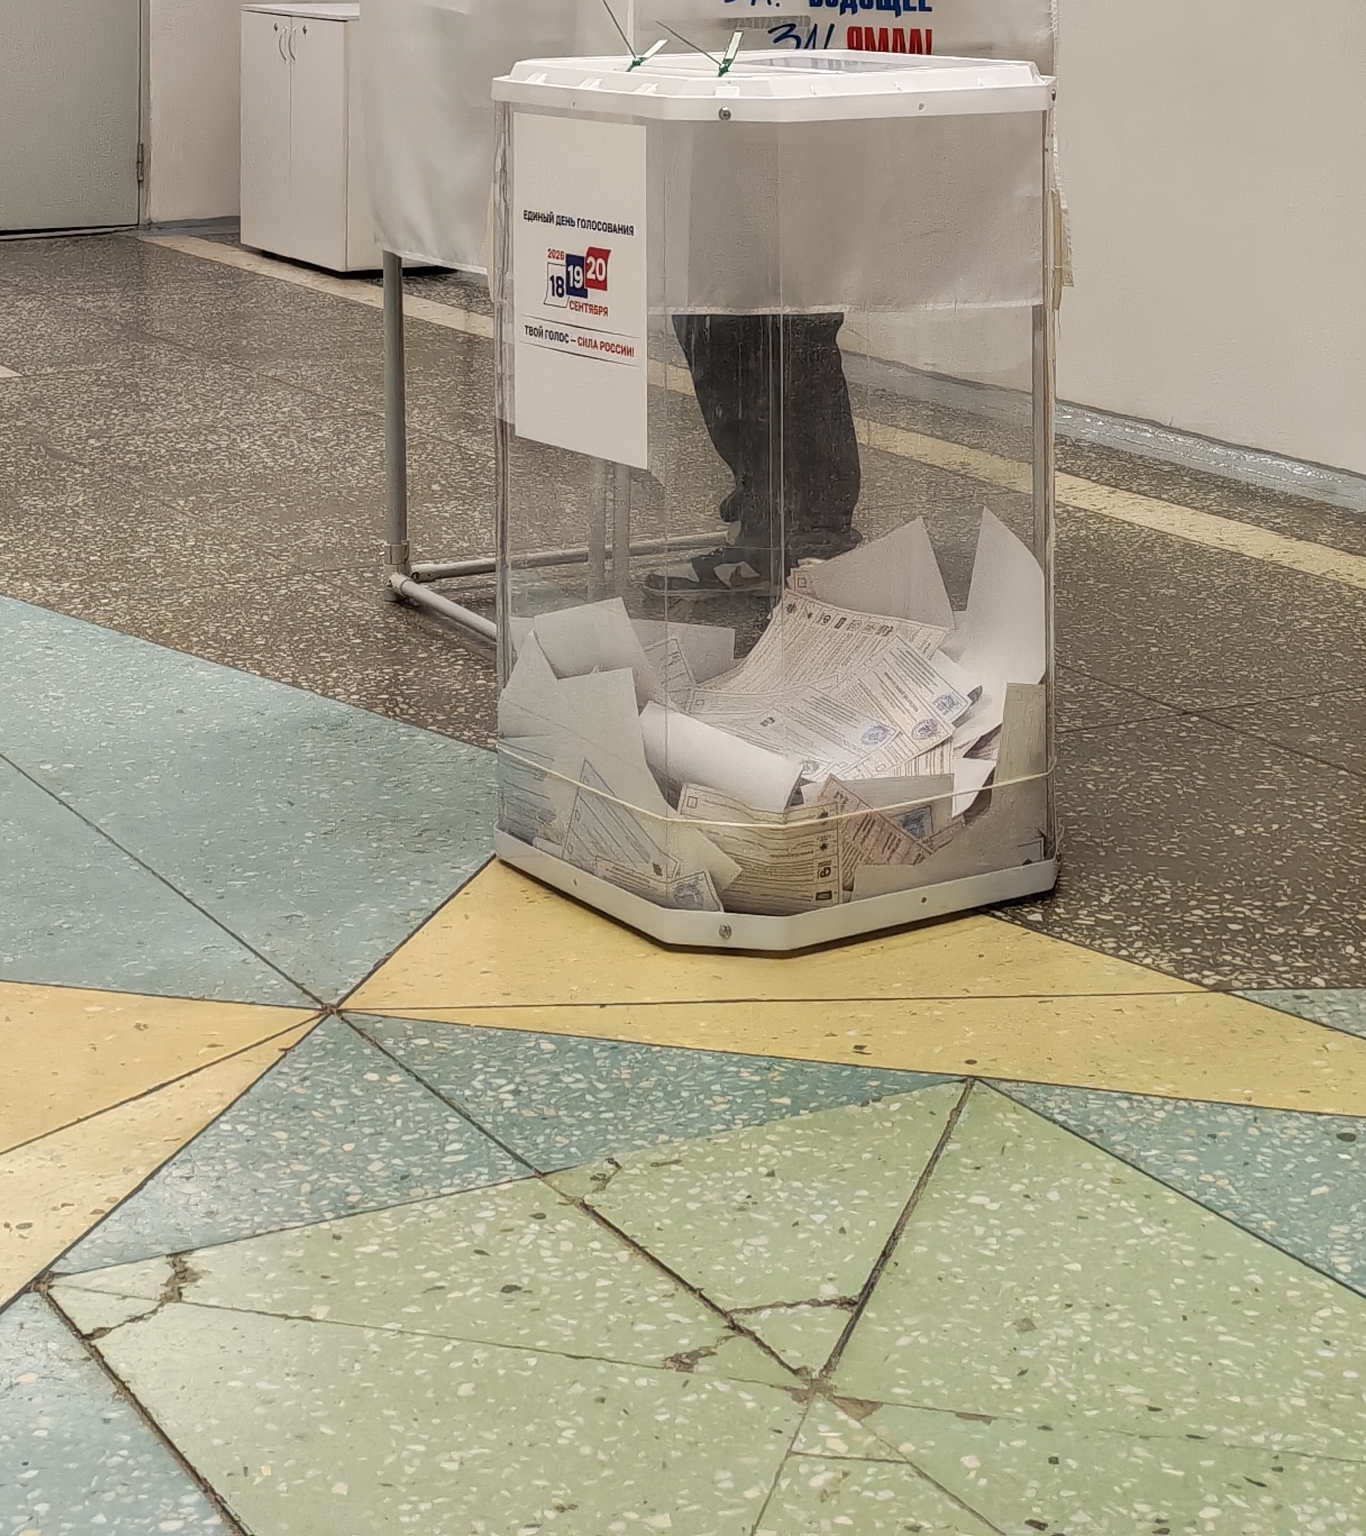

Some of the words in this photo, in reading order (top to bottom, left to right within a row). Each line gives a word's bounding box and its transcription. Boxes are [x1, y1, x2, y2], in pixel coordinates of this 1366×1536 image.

[523, 210, 554, 225] ЕДИНЫЙ
[556, 215, 575, 227] ДЕНЬ
[577, 218, 634, 236] ГОЛОСОВАНИЯ
[550, 275, 564, 298] 18
[568, 265, 583, 289] 19
[587, 256, 606, 282] 20
[569, 300, 608, 317] СЕНТЯБРЯ
[525, 325, 543, 338] ТВОЙ
[545, 329, 569, 344] ГОЛОС
[577, 337, 598, 351] СИЛА
